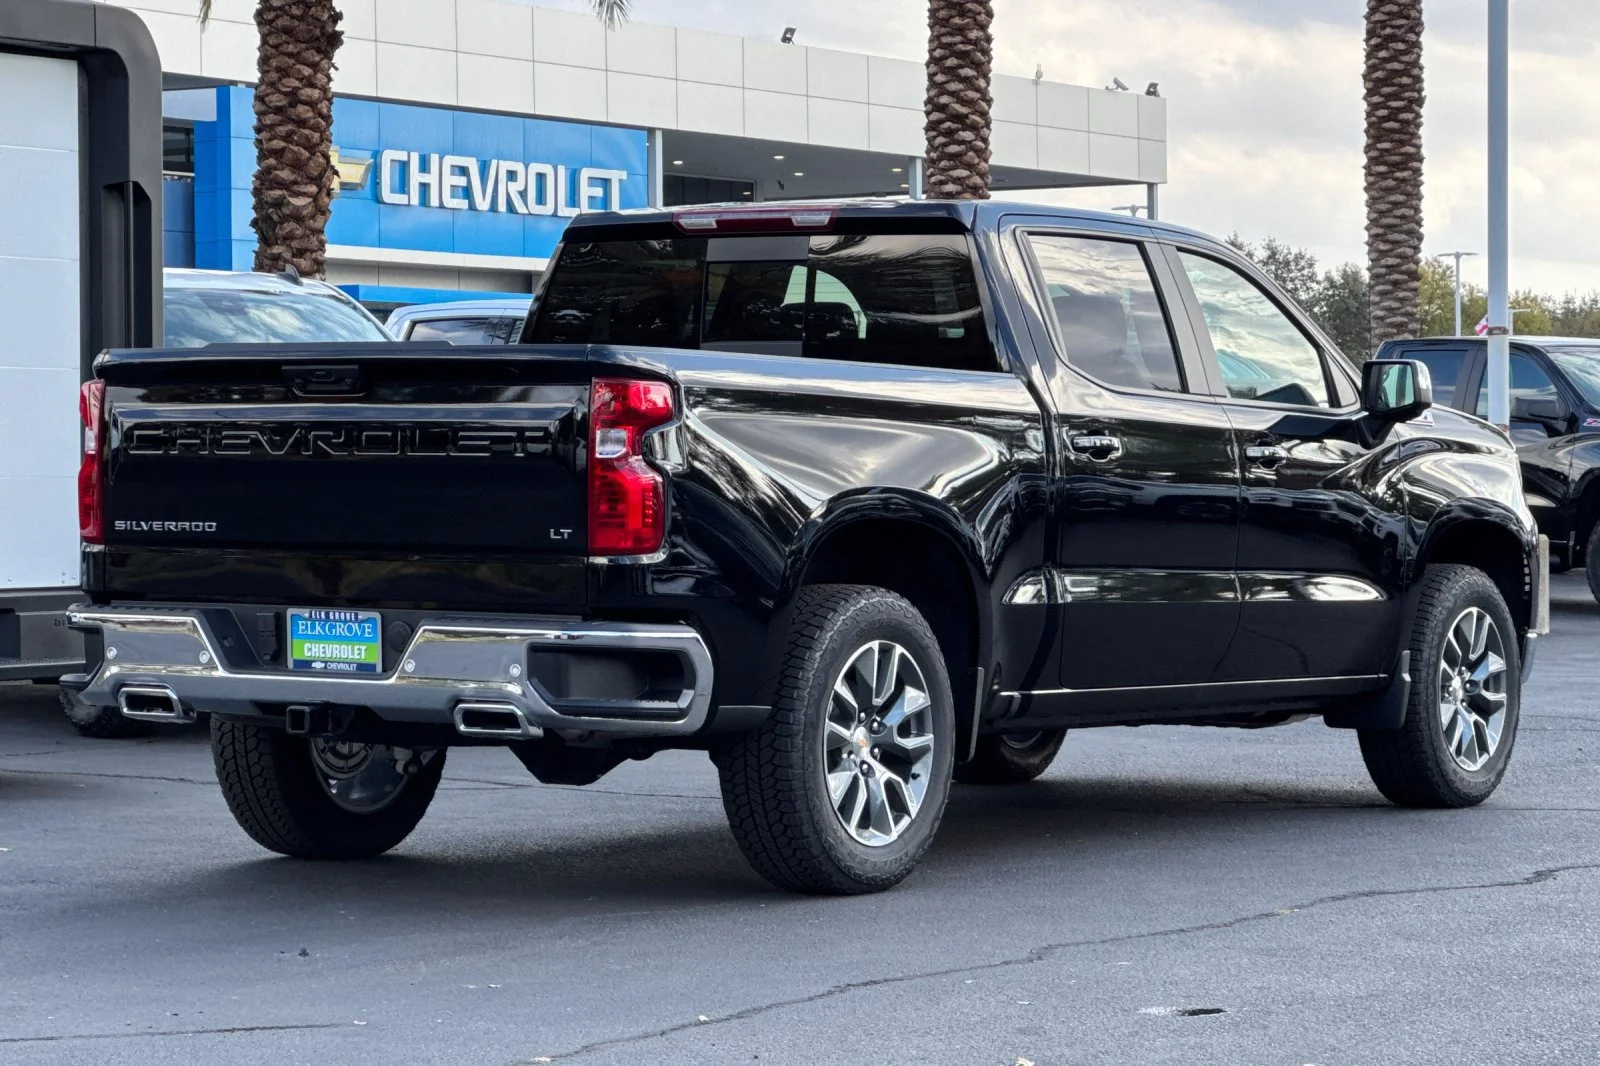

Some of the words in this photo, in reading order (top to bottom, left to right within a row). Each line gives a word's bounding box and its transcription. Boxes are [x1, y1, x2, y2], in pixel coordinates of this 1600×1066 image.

[380, 149, 627, 217] CHEVROLET
[127, 424, 546, 457] CHEVROLET
[114, 520, 217, 532] SILVERADO
[550, 528, 572, 540] LT
[311, 610, 326, 619] ELK
[329, 611, 355, 620] GROVE
[304, 643, 367, 659] CHEVROLET
[326, 662, 357, 671] CHEVROLET
